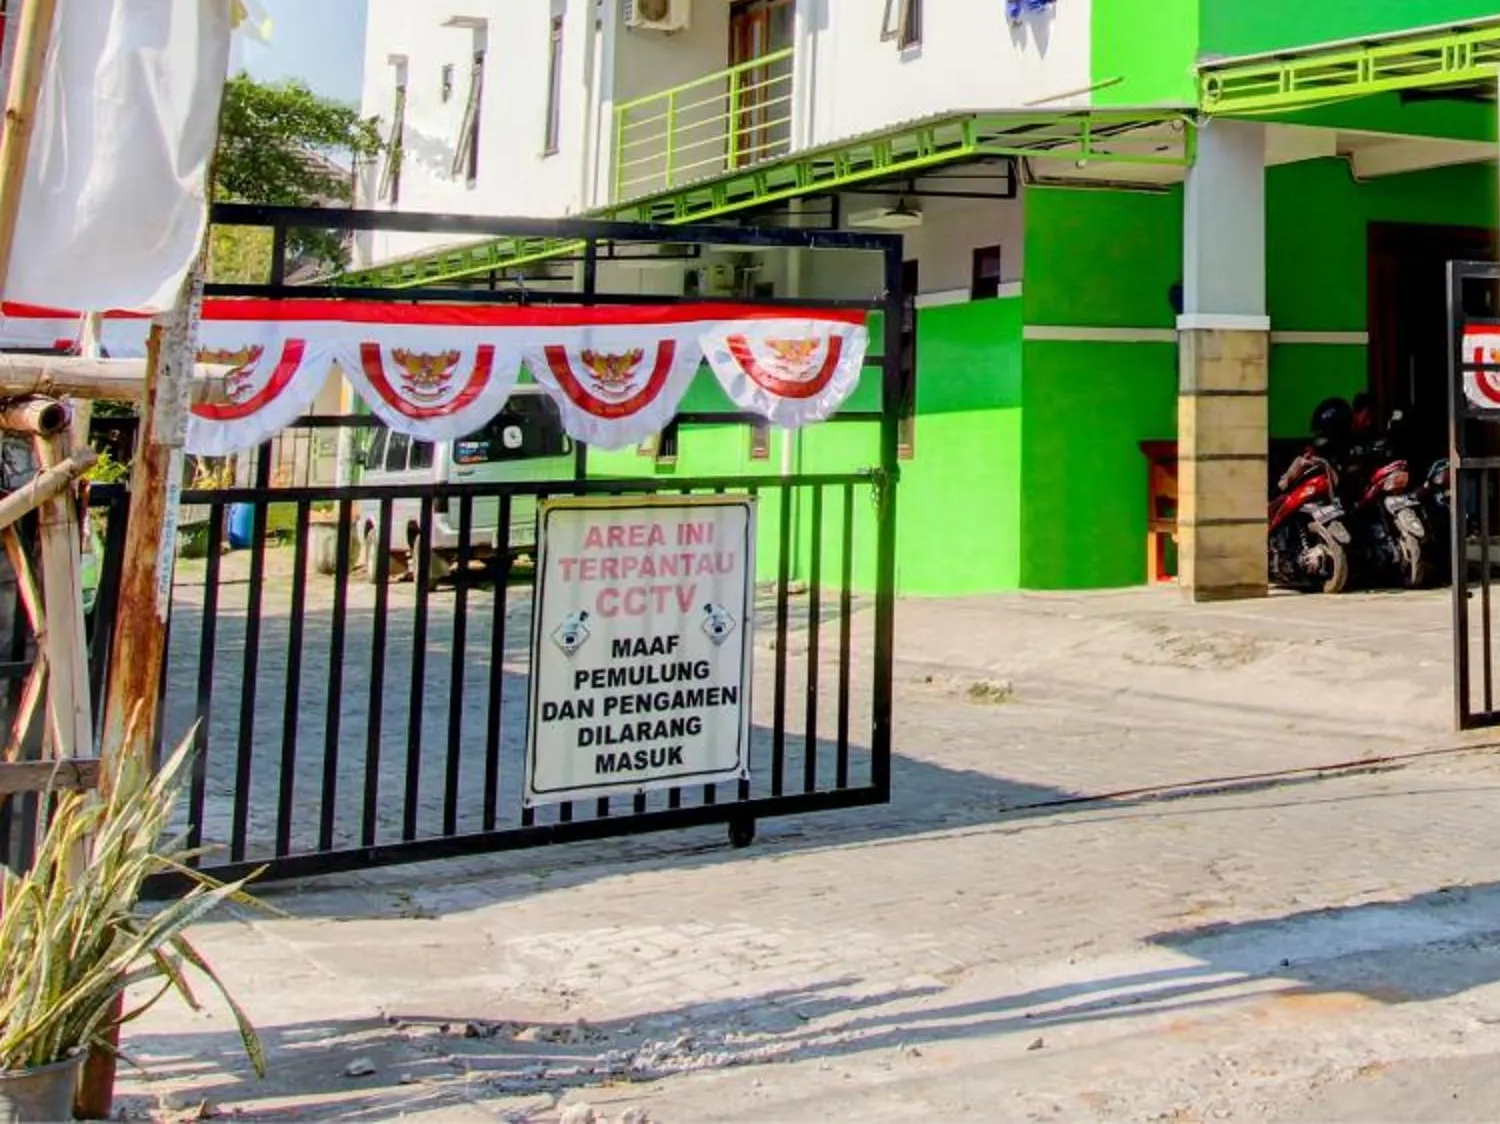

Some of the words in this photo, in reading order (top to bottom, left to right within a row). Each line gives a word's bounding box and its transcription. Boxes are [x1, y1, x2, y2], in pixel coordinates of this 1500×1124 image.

[583, 524, 666, 549] AREA
[677, 522, 714, 546] INI
[558, 552, 735, 582] TERPANTAU
[596, 584, 698, 618] CCTV
[611, 635, 680, 658] MAAF
[574, 660, 710, 690] PEMULUNG
[541, 698, 595, 722] DAN
[603, 686, 738, 717] PENGAMEN
[577, 716, 703, 748] DILARANG
[595, 746, 684, 774] MASUK
